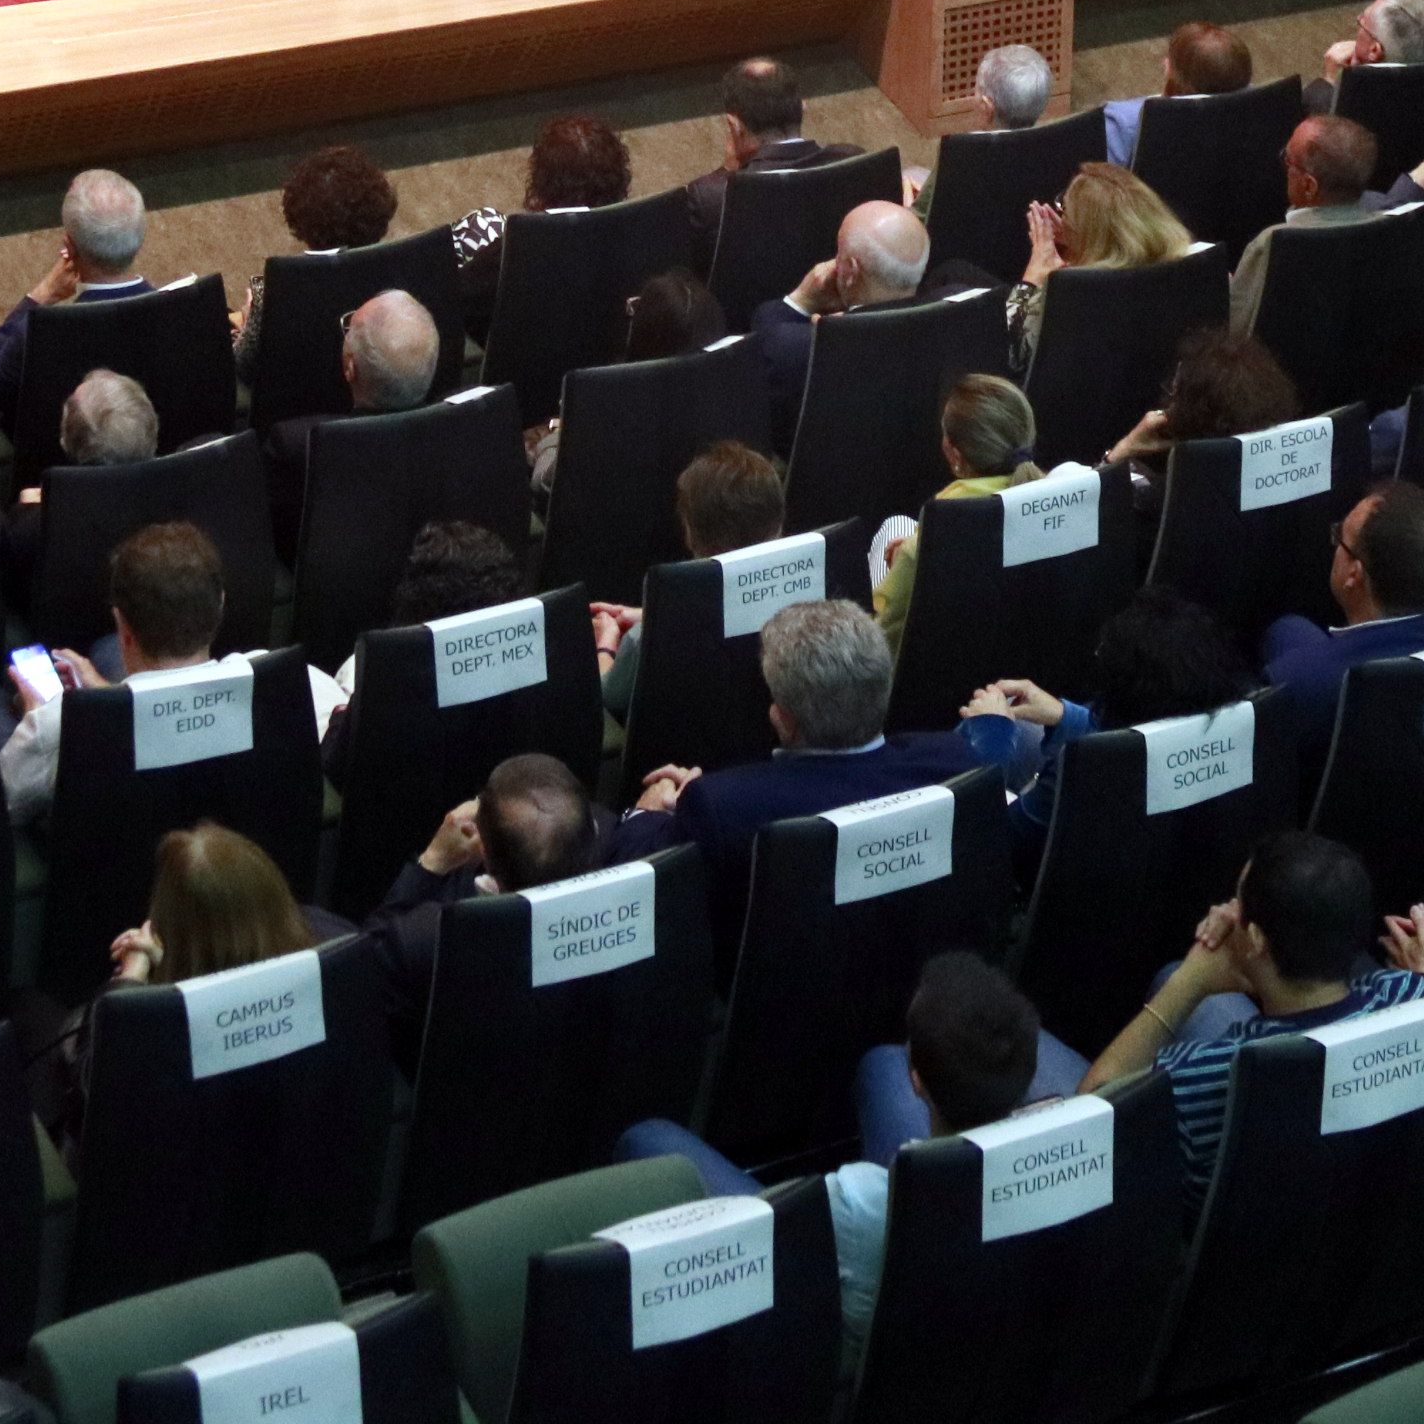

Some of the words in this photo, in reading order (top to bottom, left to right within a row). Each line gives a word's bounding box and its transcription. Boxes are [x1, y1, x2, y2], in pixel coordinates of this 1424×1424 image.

[1250, 438, 1275, 456] DIR.
[1281, 426, 1328, 448] ESCOLA
[1281, 451, 1297, 466] DE
[1255, 463, 1321, 490] DOCTORAT
[1021, 490, 1086, 516] DEGANAT
[1044, 514, 1065, 531] FIF
[738, 558, 814, 587] DIRECTORA
[742, 584, 778, 604] DEPT.
[783, 576, 811, 594] CMB
[445, 621, 537, 656] DIRECTORA
[452, 653, 494, 676] DEPT.
[502, 642, 533, 663] MEX
[153, 699, 187, 718] DIR.
[193, 689, 236, 710] DEPT.
[176, 714, 215, 733] EIDD
[1167, 738, 1235, 769] CONSELL
[1174, 761, 1228, 789] SOCIAL
[857, 828, 932, 858] CONSELL
[864, 852, 924, 879] SOCIAL
[547, 909, 612, 940] SÍNDIC
[618, 901, 639, 922] DE
[553, 927, 636, 961] GREUGES
[216, 992, 295, 1028] CAMPUS
[223, 1017, 293, 1051] IBERUS
[1353, 1039, 1421, 1071] CONSELL
[1012, 1139, 1089, 1175] CONSELL
[992, 1153, 1107, 1204] ESTUDIANTAT
[664, 1242, 746, 1278] CONSELL
[642, 1255, 768, 1308] ESTUDIANTAT
[259, 1385, 311, 1415] IREL
